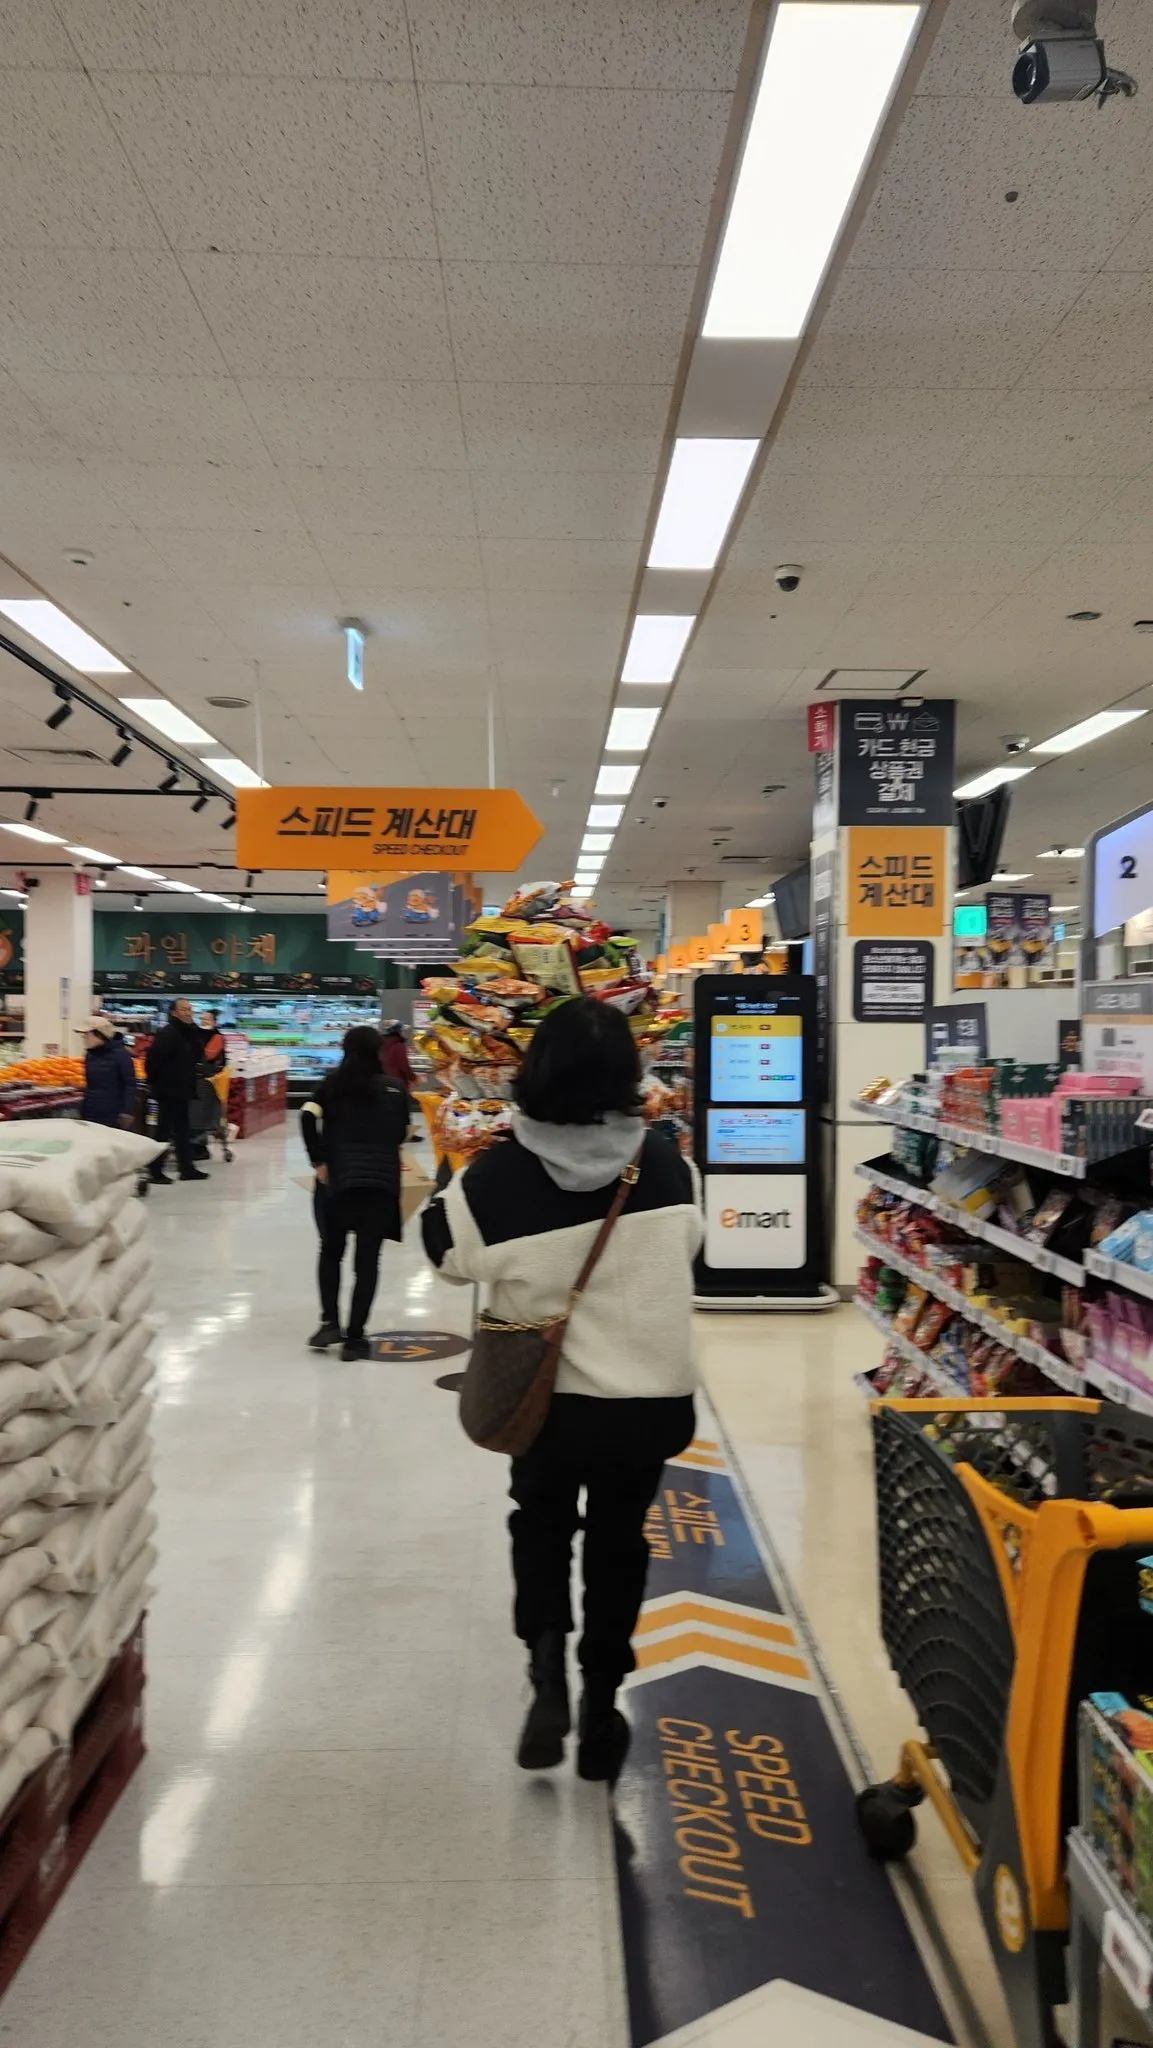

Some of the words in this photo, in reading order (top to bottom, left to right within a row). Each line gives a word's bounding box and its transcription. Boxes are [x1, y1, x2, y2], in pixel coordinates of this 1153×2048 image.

[858, 738, 896, 757] 카드
[899, 738, 936, 757] 현금
[868, 760, 925, 779] 상품권
[878, 782, 916, 801] 결제
[277, 806, 375, 837] 스피드
[381, 807, 478, 839] 계산대
[372, 843, 408, 855] SPEED
[411, 844, 469, 856] CHECKOUT
[857, 855, 935, 879] 스피드
[1119, 855, 1139, 879] 2
[858, 882, 936, 907] 계산대
[740, 924, 751, 941] 3
[122, 931, 189, 965] 과일
[209, 932, 277, 967] 야채
[720, 1208, 791, 1229] emart
[664, 1489, 725, 1546] 스피드
[724, 1728, 813, 1846] SPEED
[656, 1716, 756, 1919] CHECKOUT
